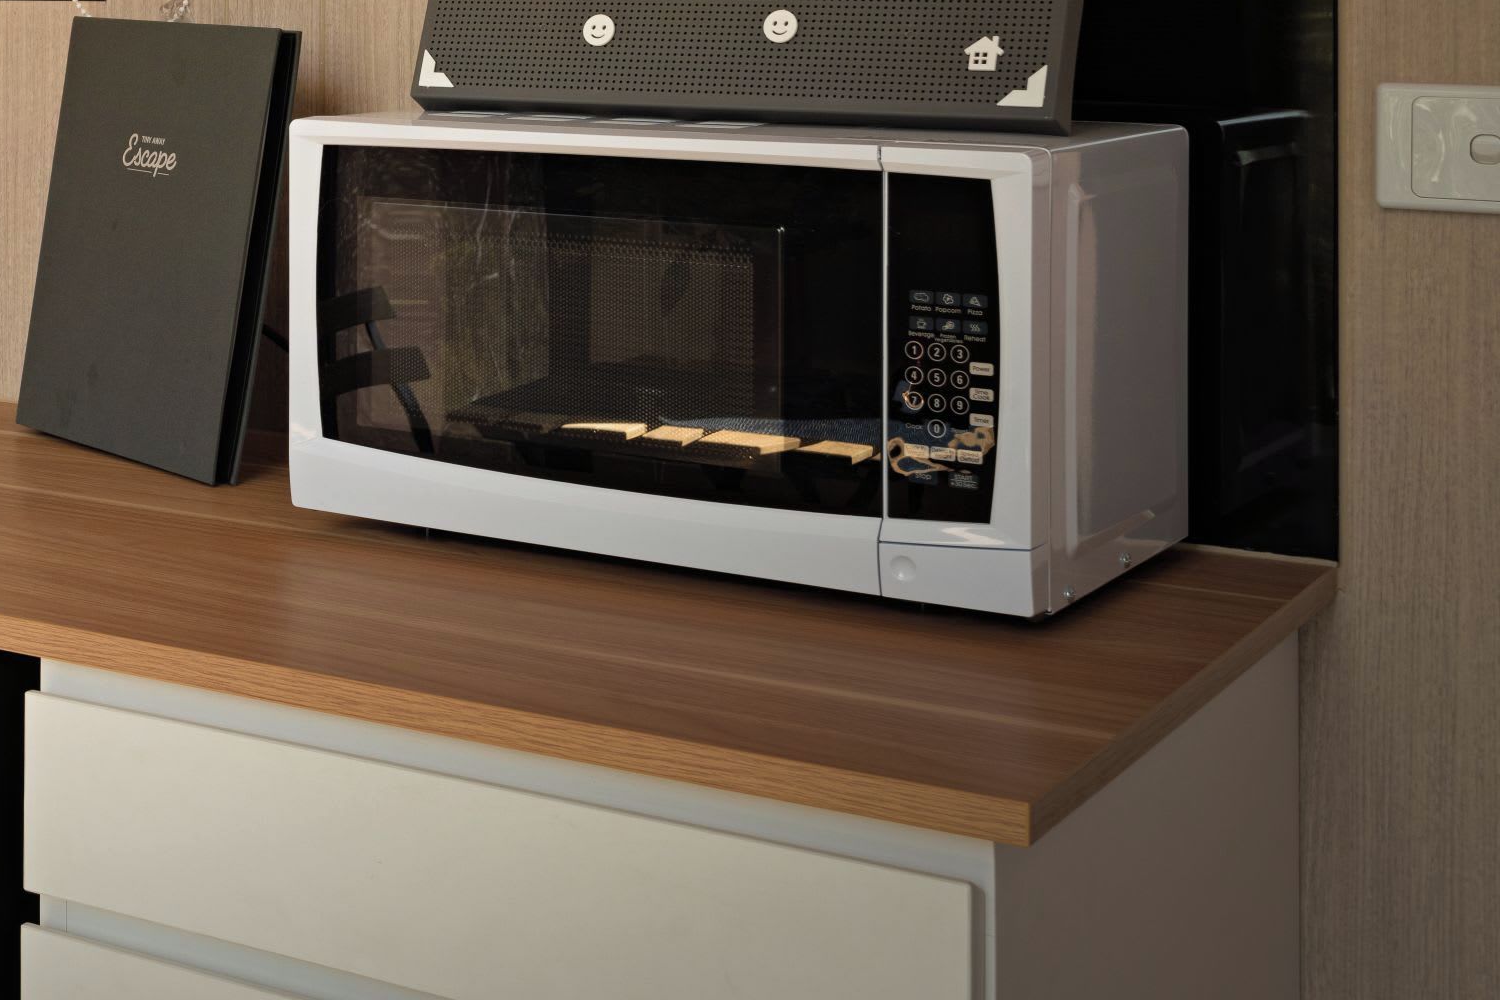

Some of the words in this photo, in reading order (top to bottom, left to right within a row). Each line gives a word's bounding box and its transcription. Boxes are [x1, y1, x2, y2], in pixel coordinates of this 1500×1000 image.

[123, 133, 177, 178] Escape
[911, 304, 932, 312] Potato
[964, 335, 986, 343] Reheat
